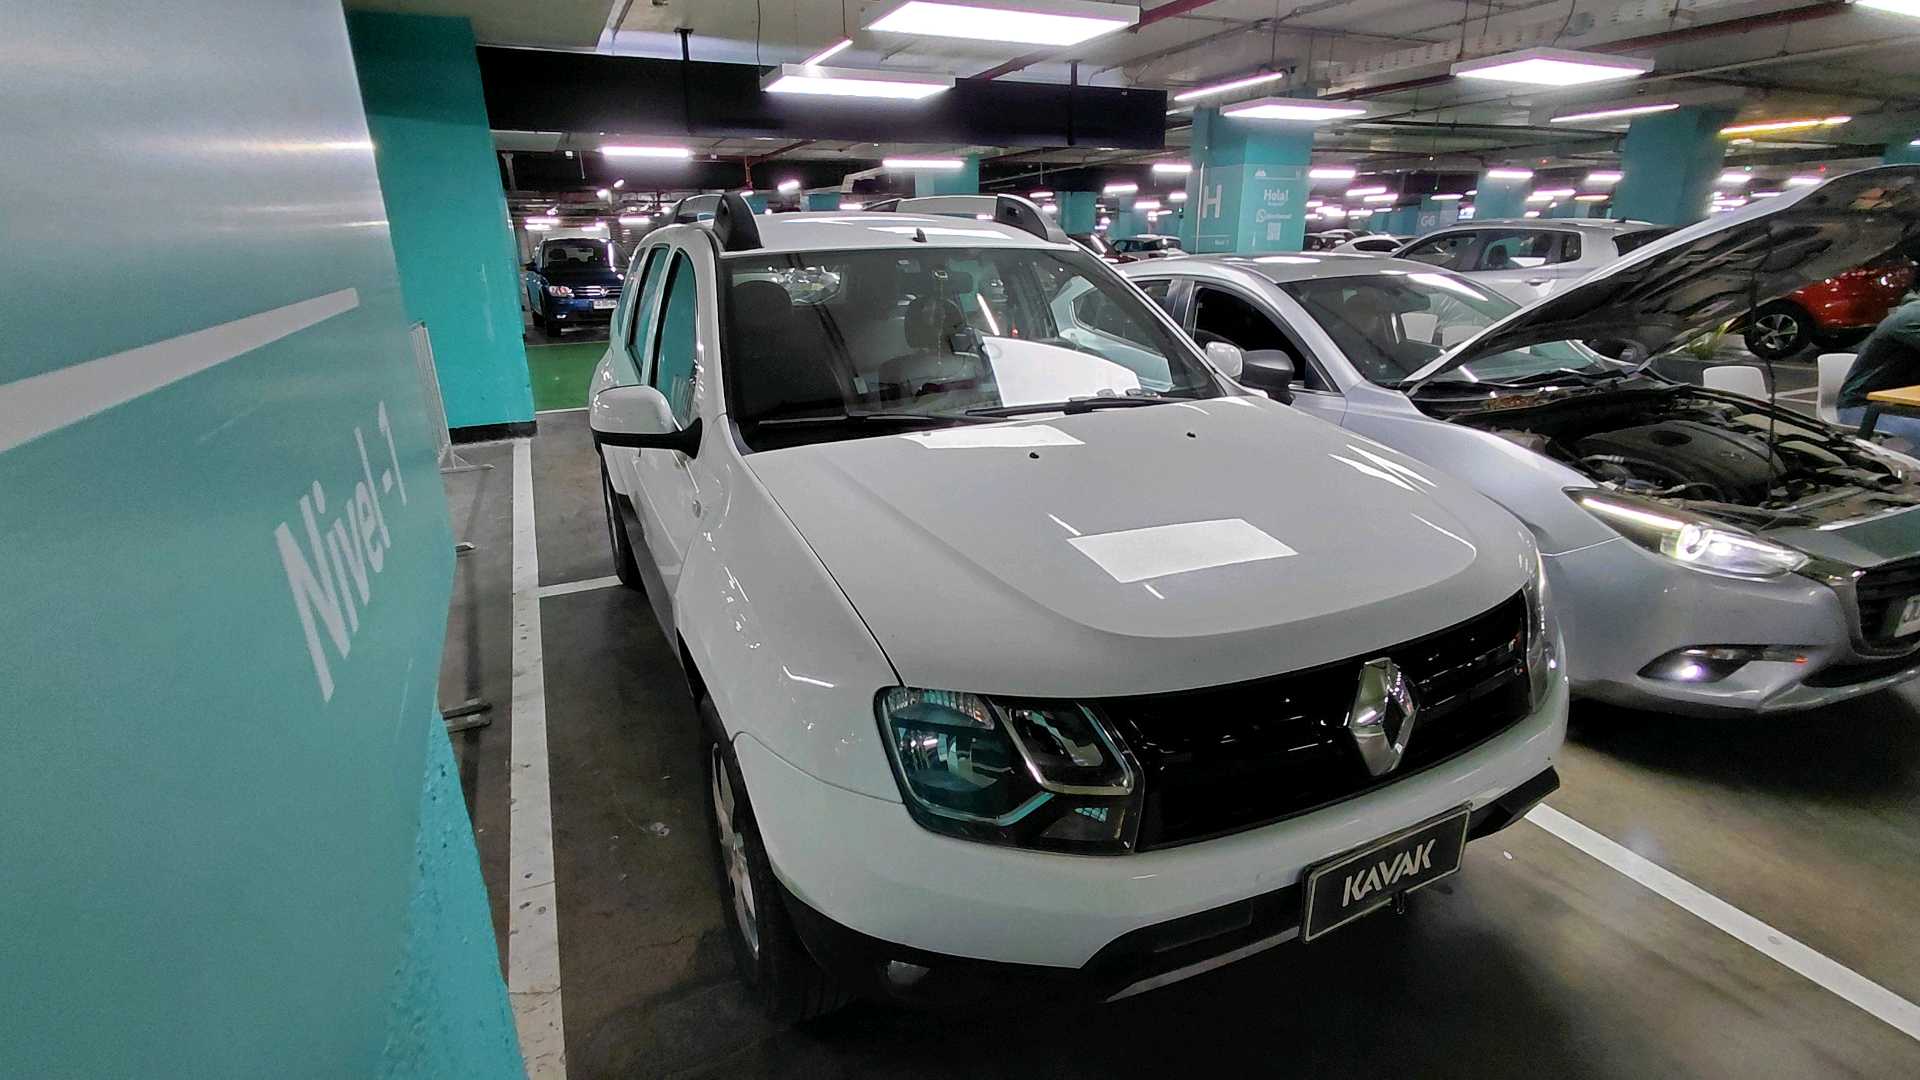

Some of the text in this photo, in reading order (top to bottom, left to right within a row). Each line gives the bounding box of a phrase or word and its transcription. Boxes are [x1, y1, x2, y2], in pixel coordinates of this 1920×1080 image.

[1202, 184, 1222, 219] H
[274, 426, 392, 704] Nivel
[1342, 838, 1436, 907] KAVAK
